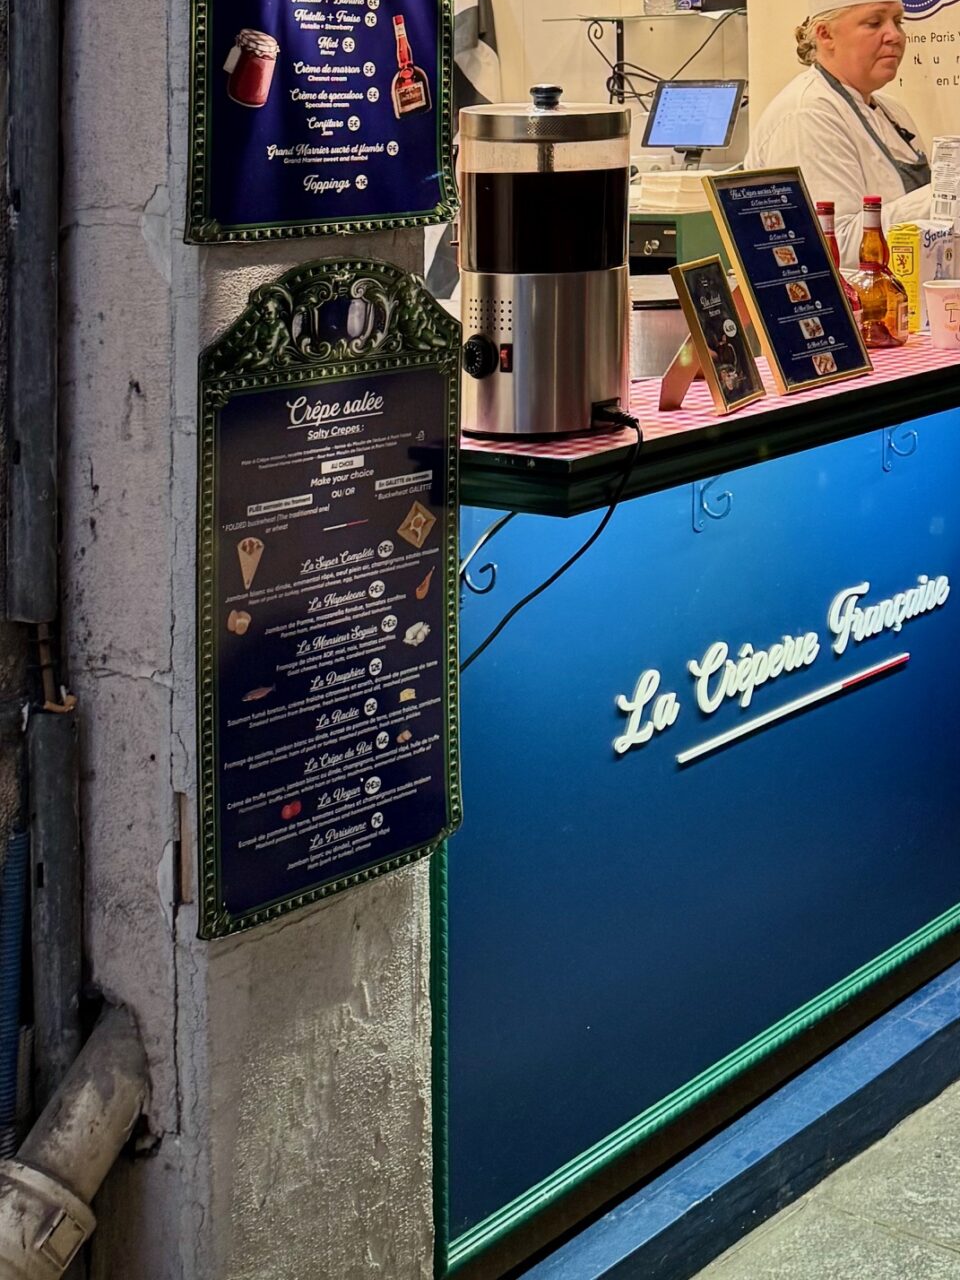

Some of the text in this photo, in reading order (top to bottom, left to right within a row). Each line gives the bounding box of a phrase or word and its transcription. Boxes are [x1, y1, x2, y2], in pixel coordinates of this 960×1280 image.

[294, 9, 325, 22] Nutella
[335, 9, 361, 23] Fraise
[318, 36, 338, 49] Miel
[930, 32, 955, 43] Paris
[294, 62, 320, 74] Crème
[322, 65, 331, 73] de
[290, 88, 316, 101] Crème
[318, 90, 328, 100] de
[307, 117, 344, 131] Confiture
[267, 145, 294, 160] Grand
[296, 144, 329, 157] Marnier
[330, 143, 349, 154] sucré
[351, 144, 359, 154] et
[359, 143, 384, 156] flambé
[303, 174, 350, 193] Toppings
[286, 391, 384, 427] Crêpe salée
[307, 427, 329, 441] Salty
[310, 469, 374, 487] Make your choice
[301, 562, 314, 572] La
[315, 554, 338, 571] Super
[307, 600, 322, 612] La
[296, 641, 312, 654] La
[313, 632, 350, 651] Monsieur
[352, 622, 378, 642] Seguin
[613, 574, 951, 754] La Crêperie Française
[309, 679, 325, 690] La
[326, 667, 366, 687] Dauphine
[316, 716, 329, 729] La
[304, 758, 318, 772] La
[320, 752, 343, 771] Crêpe
[344, 747, 354, 759] du
[356, 741, 372, 755] Roi
[318, 795, 331, 808] La
[333, 787, 361, 803] Vegan
[309, 836, 324, 850] La
[325, 822, 367, 844] Parisienne
